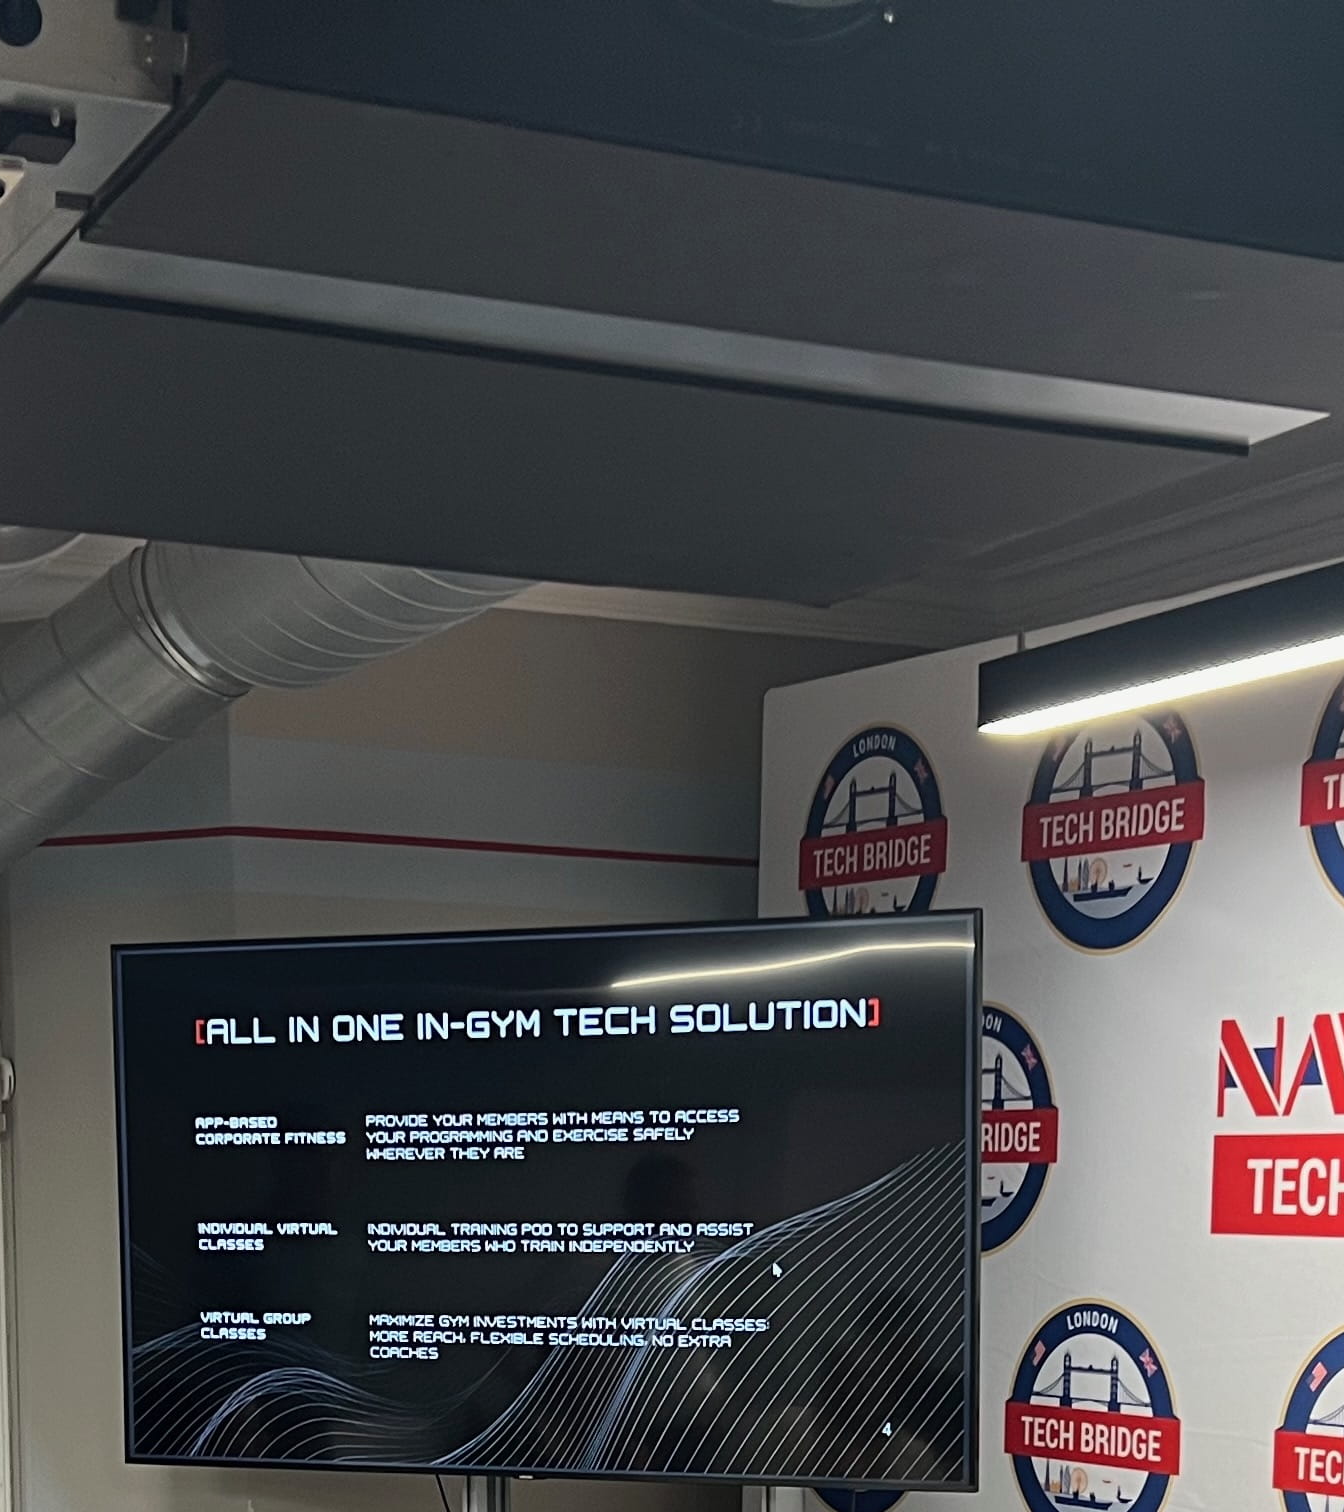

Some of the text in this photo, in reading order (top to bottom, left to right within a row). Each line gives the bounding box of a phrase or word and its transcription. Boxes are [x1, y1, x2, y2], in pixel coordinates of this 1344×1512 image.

[852, 734, 896, 758] LONDON
[1039, 798, 1185, 849] TECH BRIDGE
[813, 834, 932, 878] TECH BRIDGE
[288, 1015, 319, 1043] IN
[332, 1013, 404, 1042] ONE
[417, 1009, 540, 1041] IN-GYM
[553, 1005, 656, 1036] TECH
[195, 1116, 278, 1129] APP-BASED
[365, 1109, 740, 1127] PROVIDE YOUR MEMBERS WITH MEANS TO ACCESS
[195, 1131, 346, 1145] CORPORATE FITNESS
[366, 1128, 695, 1144] YOUR PROGRAMMING AND EXERCISE SAFELY
[981, 1122, 1041, 1153] RIDGE
[366, 1147, 525, 1160] WHEREVER THEY ARE
[197, 1223, 338, 1235] INDIVIDUAL VIRTUAL
[367, 1223, 754, 1236] INDIVIDUAL TRAINING POD TO SUPPORT AND ASSIST
[198, 1238, 264, 1250] CLASSES
[368, 1240, 695, 1253] YOUR MEMBERS WHO TRAIN INDEPENDENTLY
[200, 1311, 312, 1325] VIRTUAL GROUP
[369, 1314, 434, 1327] MAXIMIZE
[439, 1315, 469, 1328] GYM
[473, 1316, 578, 1329] INVESTMENTS
[581, 1317, 616, 1330] WITH
[621, 1318, 687, 1331] VIRTUAL
[1066, 1311, 1119, 1334] LONDON
[200, 1328, 267, 1340] CLASSES
[370, 1331, 408, 1343] MORE
[471, 1332, 544, 1345] FLEXIBLE
[652, 1334, 674, 1347] NO
[678, 1335, 732, 1348] EXTRA
[370, 1347, 439, 1360] COACHES
[882, 1422, 892, 1437] 4
[1021, 1415, 1162, 1462] TECH BRIDGE
